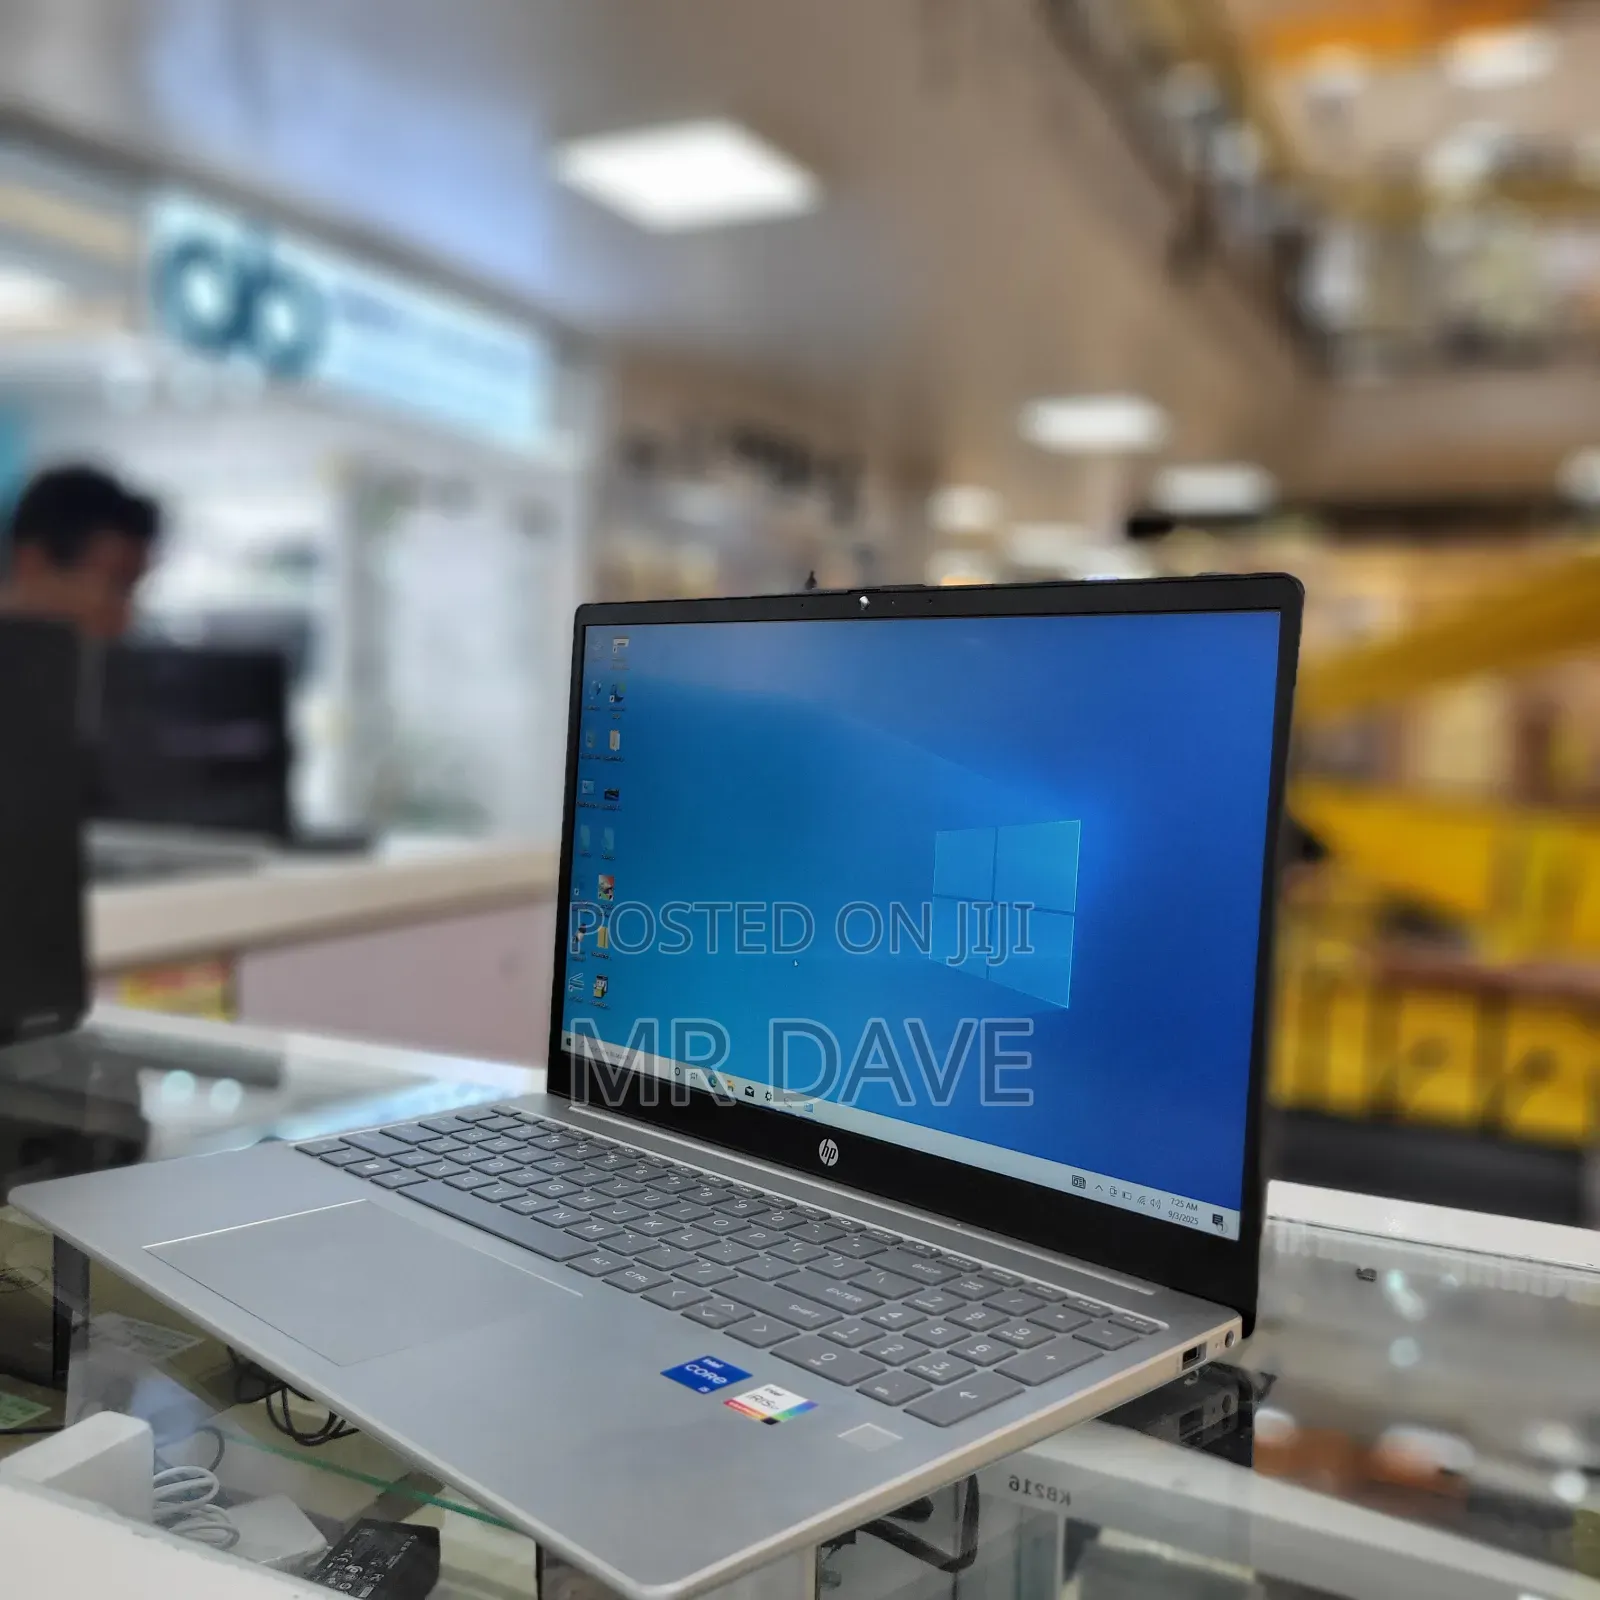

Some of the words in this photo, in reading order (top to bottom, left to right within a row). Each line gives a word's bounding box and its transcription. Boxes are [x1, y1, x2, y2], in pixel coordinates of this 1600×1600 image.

[819, 1138, 839, 1167] hp
[1185, 1202, 1199, 1212] AM
[1167, 1210, 1199, 1226] 9/3/2025
[624, 1270, 649, 1284] CTRL
[825, 1287, 863, 1304] ENTER
